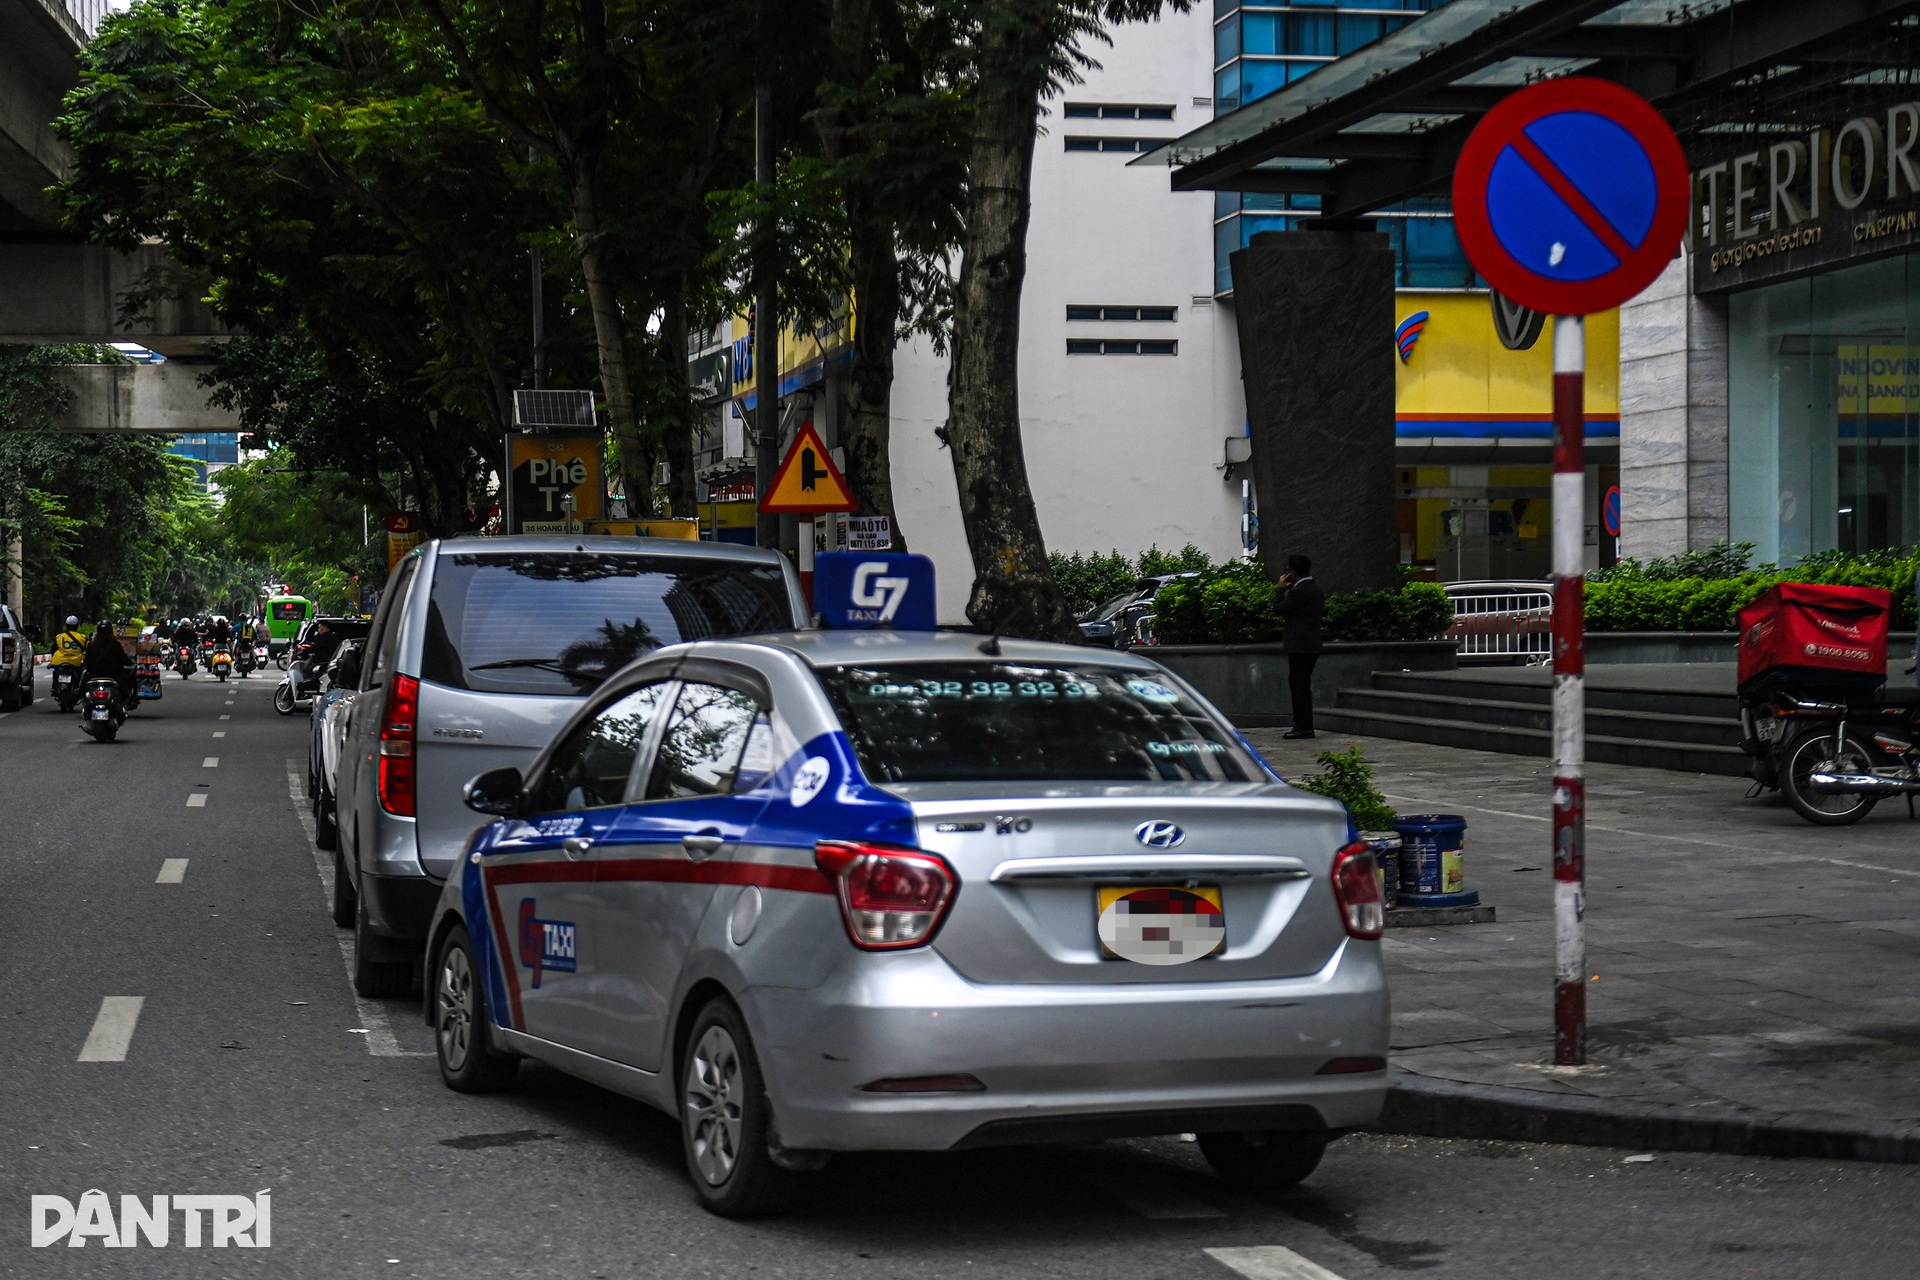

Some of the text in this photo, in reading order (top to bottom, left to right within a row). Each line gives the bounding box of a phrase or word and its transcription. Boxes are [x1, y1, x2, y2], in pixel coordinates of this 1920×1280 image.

[1687, 103, 1920, 247] TERIOR
[1854, 210, 1920, 241] CARPAN
[1867, 384, 1907, 398] BANK
[529, 457, 588, 485] Phê
[536, 524, 563, 532] HOÀNG
[864, 539, 876, 548] 115
[852, 562, 909, 621] G7
[62, 637, 78, 650] be
[922, 681, 963, 697] 32
[971, 681, 1012, 697] 32
[1018, 681, 1059, 697] 32
[1063, 682, 1102, 697] 32
[543, 923, 576, 958] TAXI
